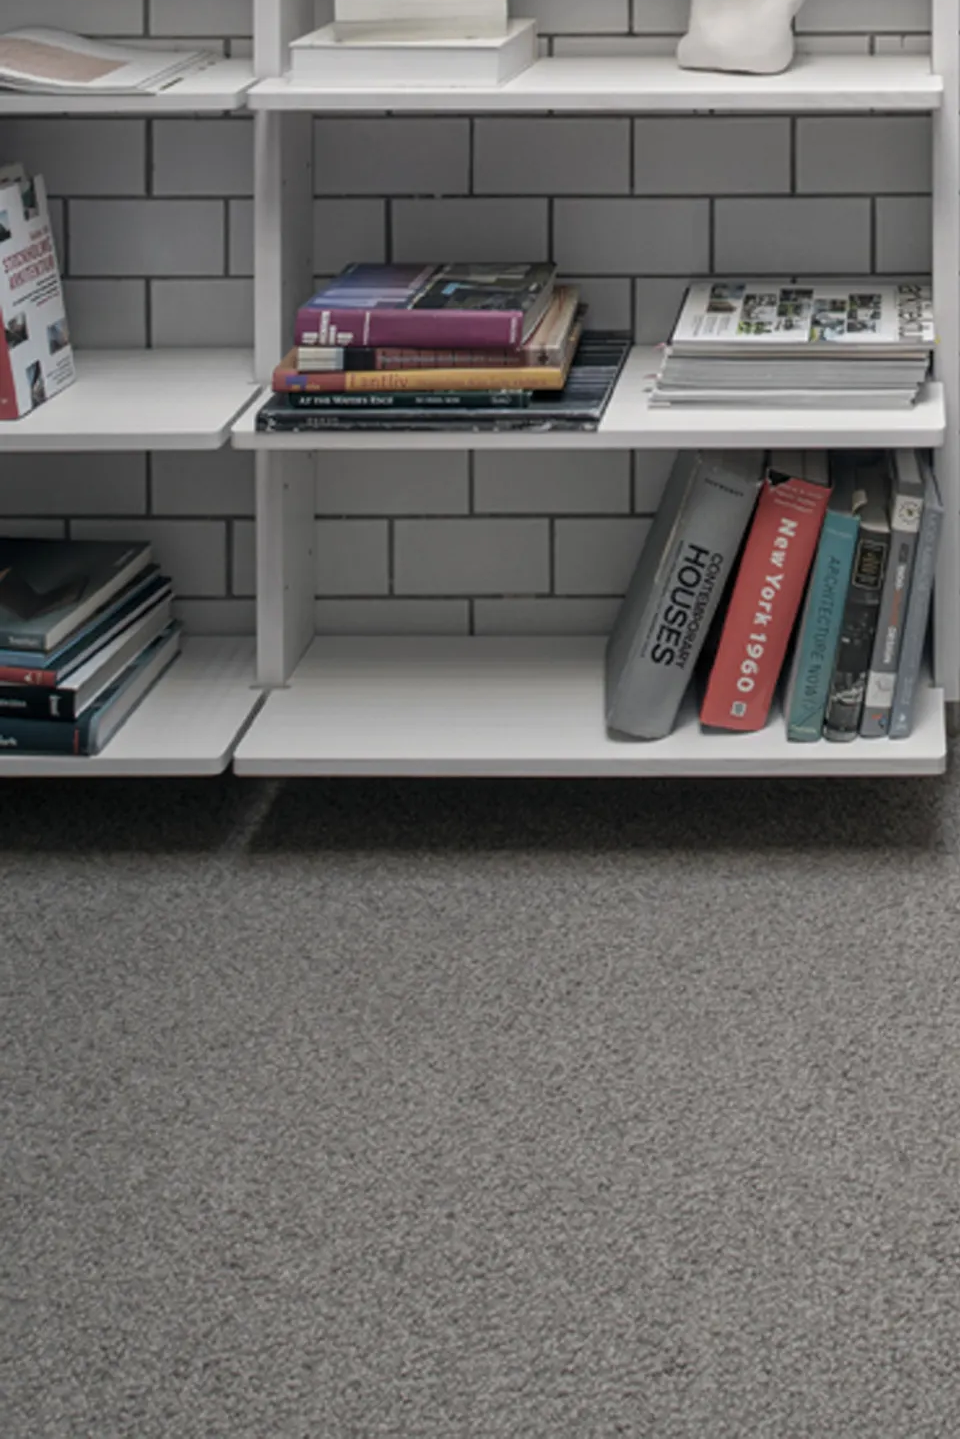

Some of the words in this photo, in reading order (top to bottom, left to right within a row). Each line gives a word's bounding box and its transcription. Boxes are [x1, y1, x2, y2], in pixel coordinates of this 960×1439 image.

[772, 517, 798, 568] New
[651, 543, 710, 667] HOUSES
[674, 553, 723, 670] CONTEMPORARY
[754, 573, 785, 626] York
[811, 555, 841, 662] ARCHITECTURE
[736, 633, 766, 693] 1960
